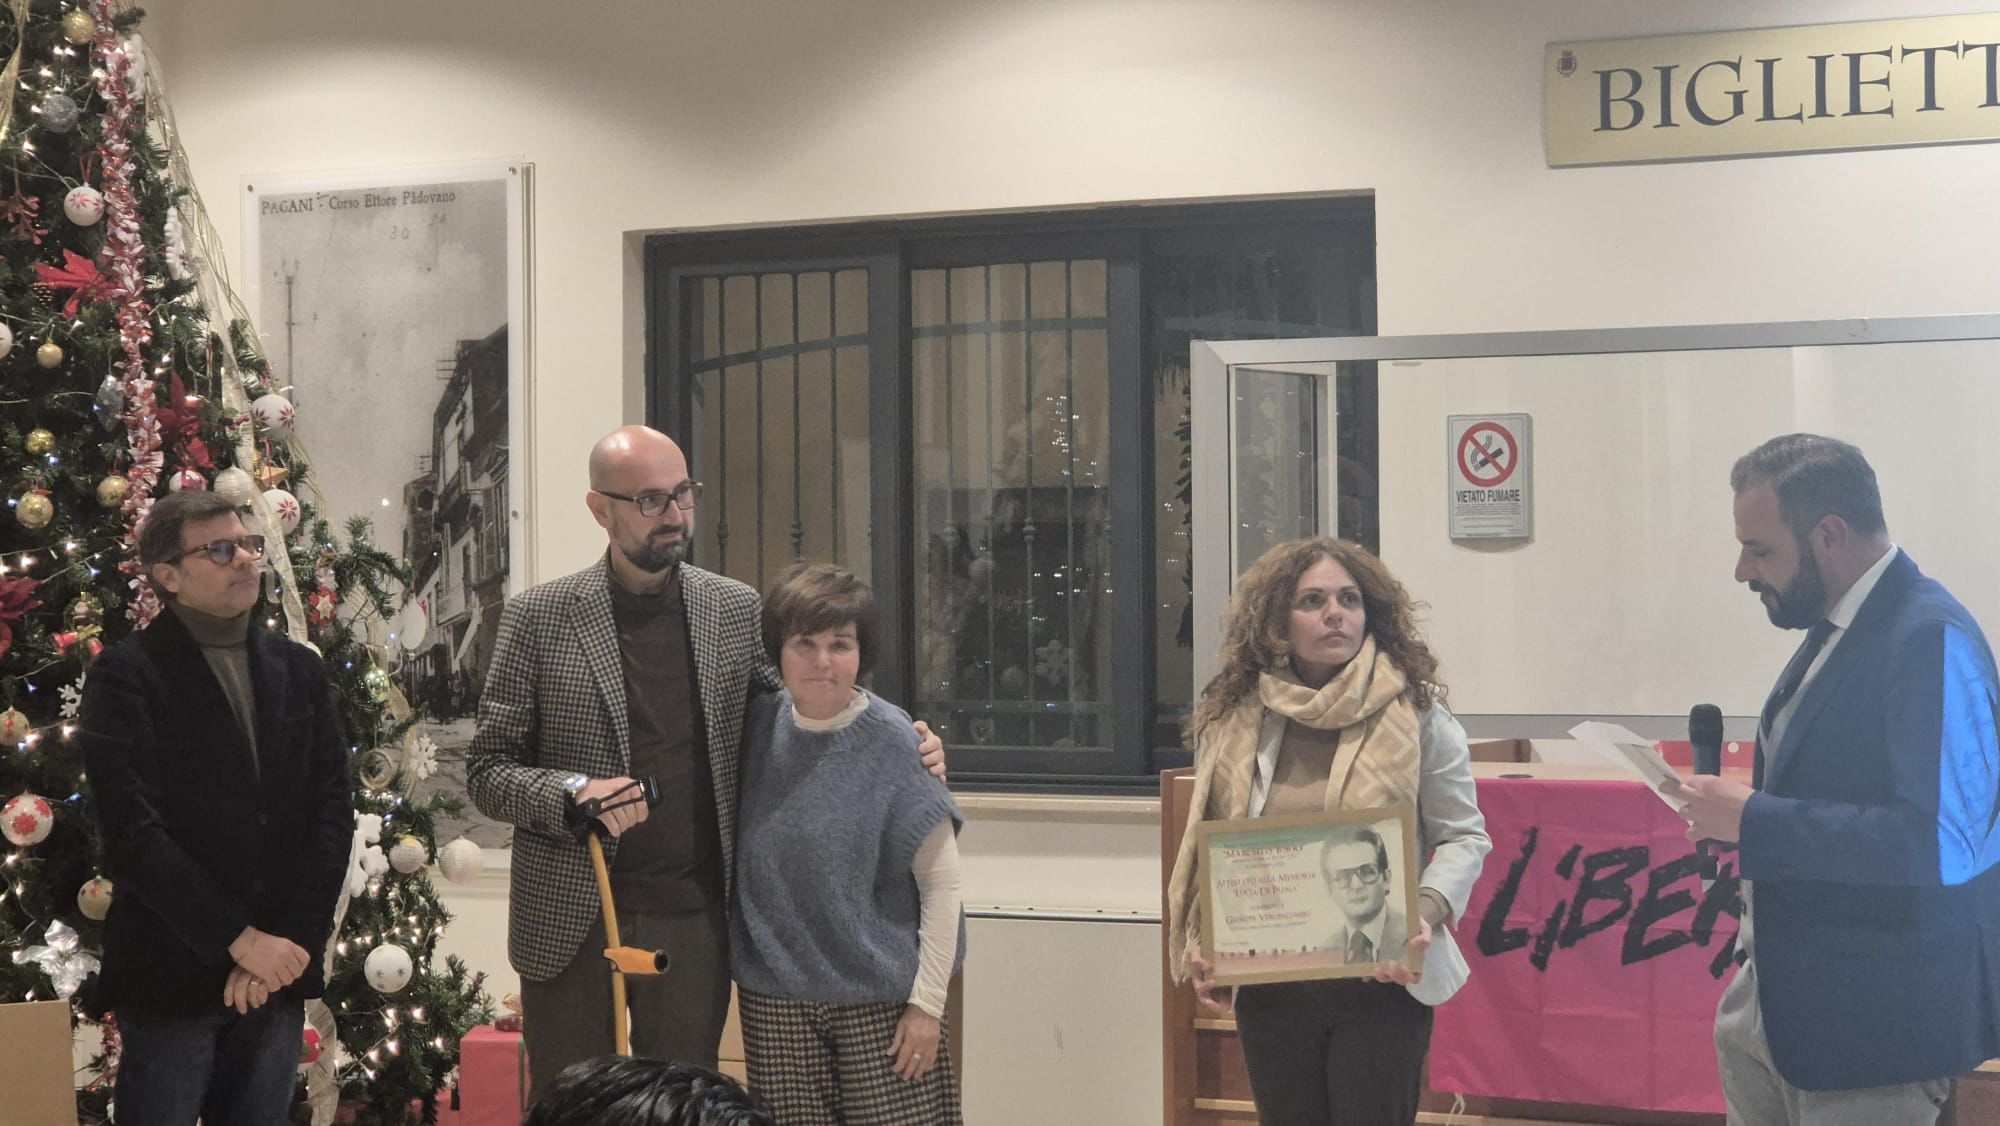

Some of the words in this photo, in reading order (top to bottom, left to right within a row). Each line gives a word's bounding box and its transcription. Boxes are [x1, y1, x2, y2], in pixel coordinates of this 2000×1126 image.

[262, 198, 313, 215] PAGANI
[329, 196, 360, 210] Corso
[363, 193, 397, 208] Ettore
[1455, 489, 1486, 503] VIETATO
[1487, 489, 1521, 502] FUMARE
